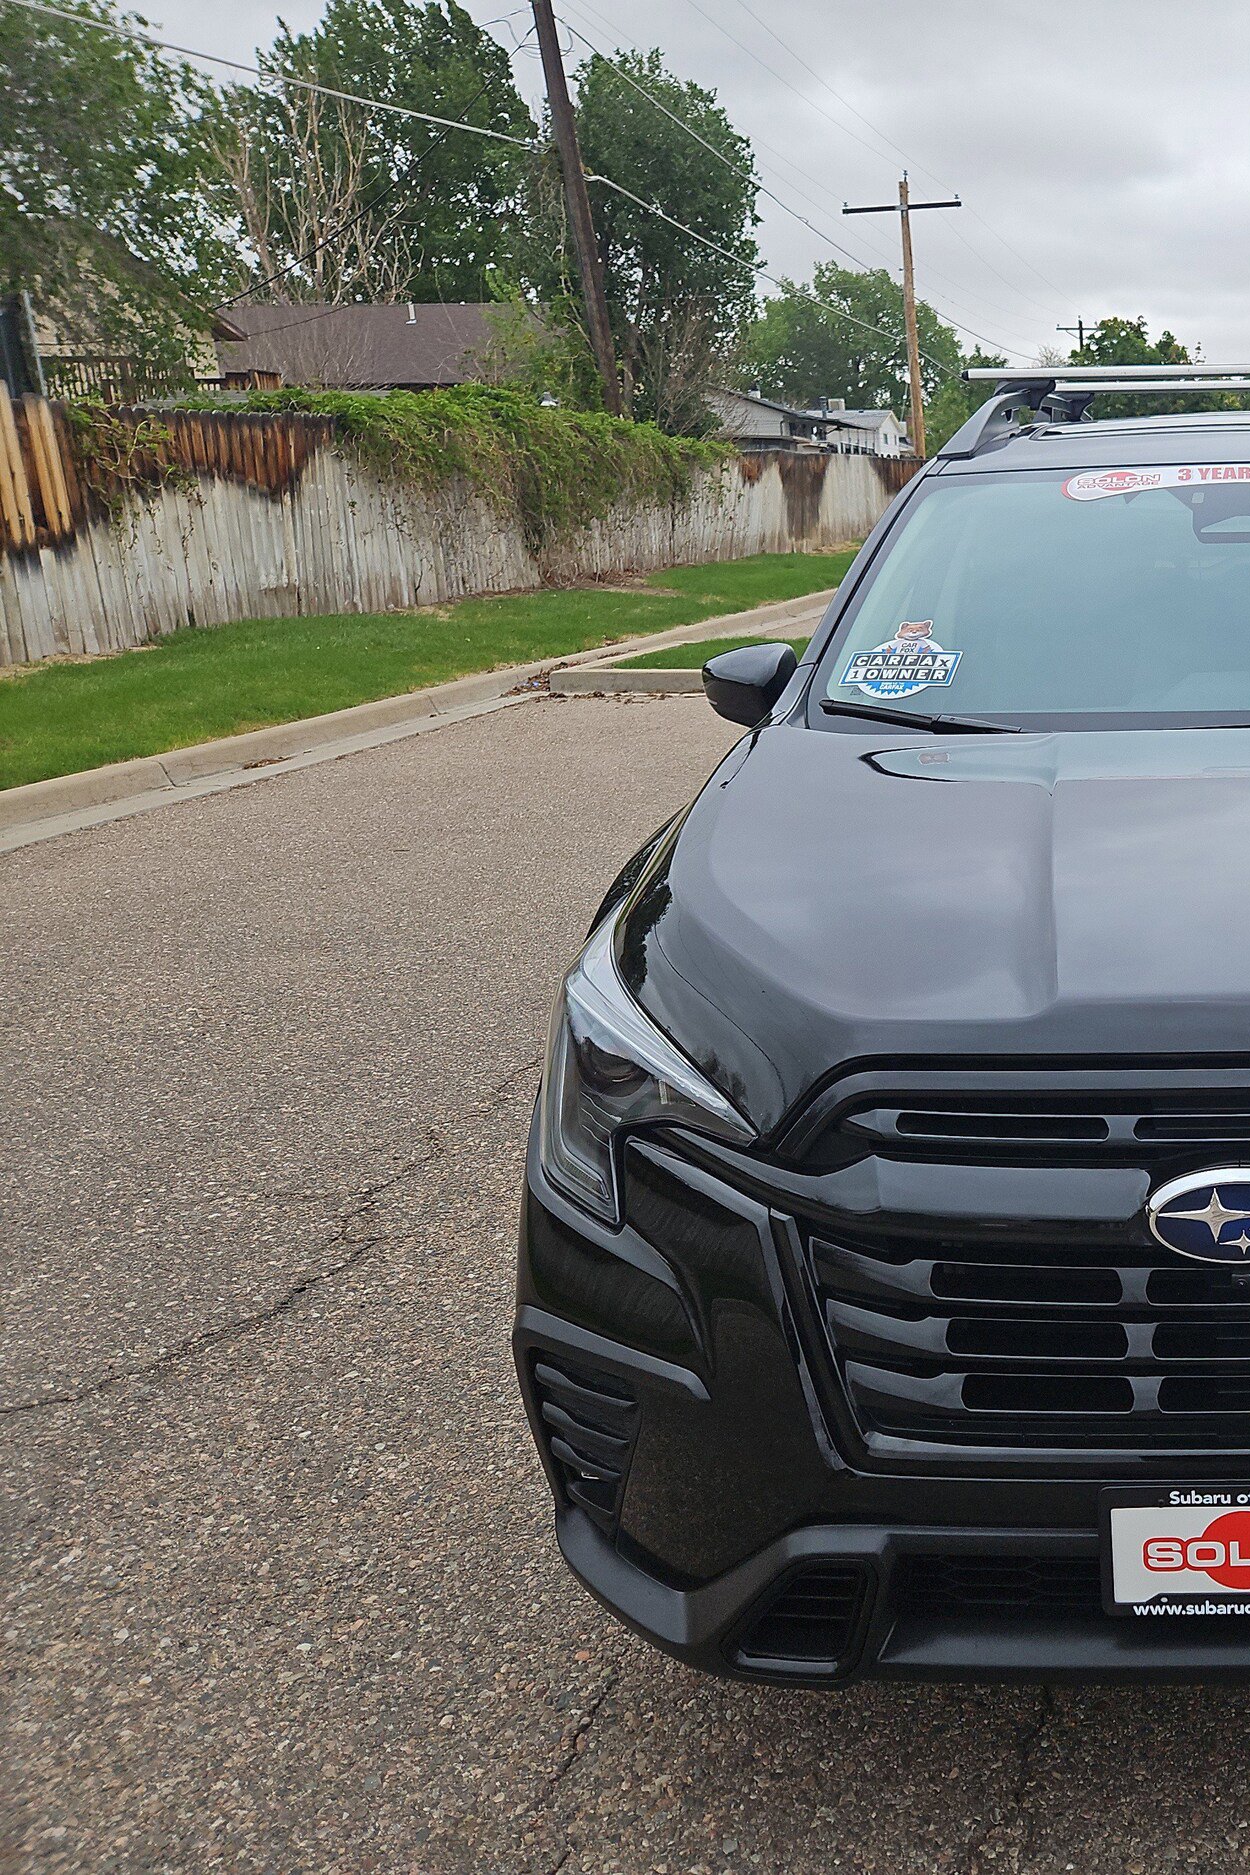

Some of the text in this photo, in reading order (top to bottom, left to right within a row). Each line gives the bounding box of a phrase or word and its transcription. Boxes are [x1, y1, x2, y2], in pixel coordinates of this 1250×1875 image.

[1077, 474, 1160, 486] SOLON
[1178, 468, 1191, 480] 3
[1077, 481, 1160, 489] ADVANTAGE
[855, 655, 951, 668] CARFAX
[850, 668, 946, 680] 1 OWNER
[1169, 1490, 1231, 1505] Subaru
